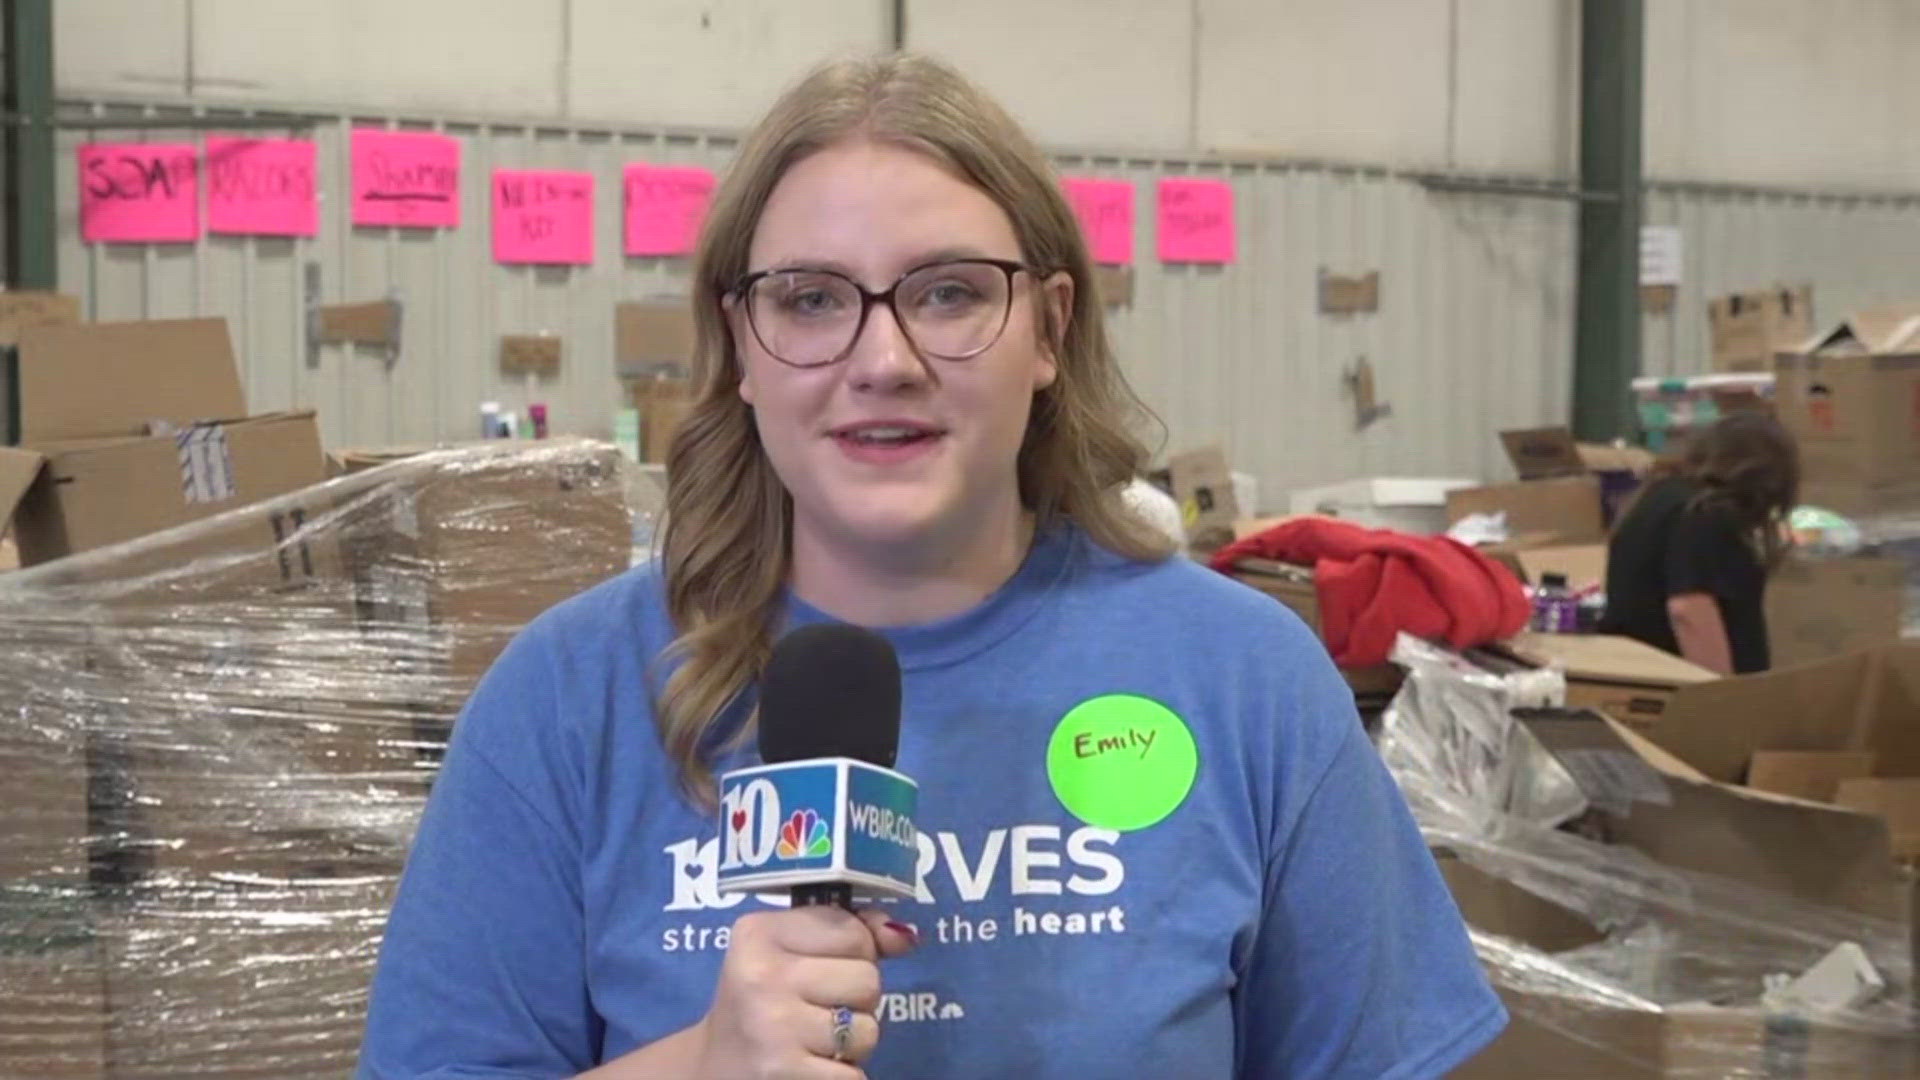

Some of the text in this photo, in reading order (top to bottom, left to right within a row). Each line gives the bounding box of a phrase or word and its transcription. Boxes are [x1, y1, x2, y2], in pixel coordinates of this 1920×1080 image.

[1074, 727, 1157, 760] Emily
[719, 778, 781, 870] 10
[936, 915, 998, 943] the
[1013, 905, 1125, 936] heart
